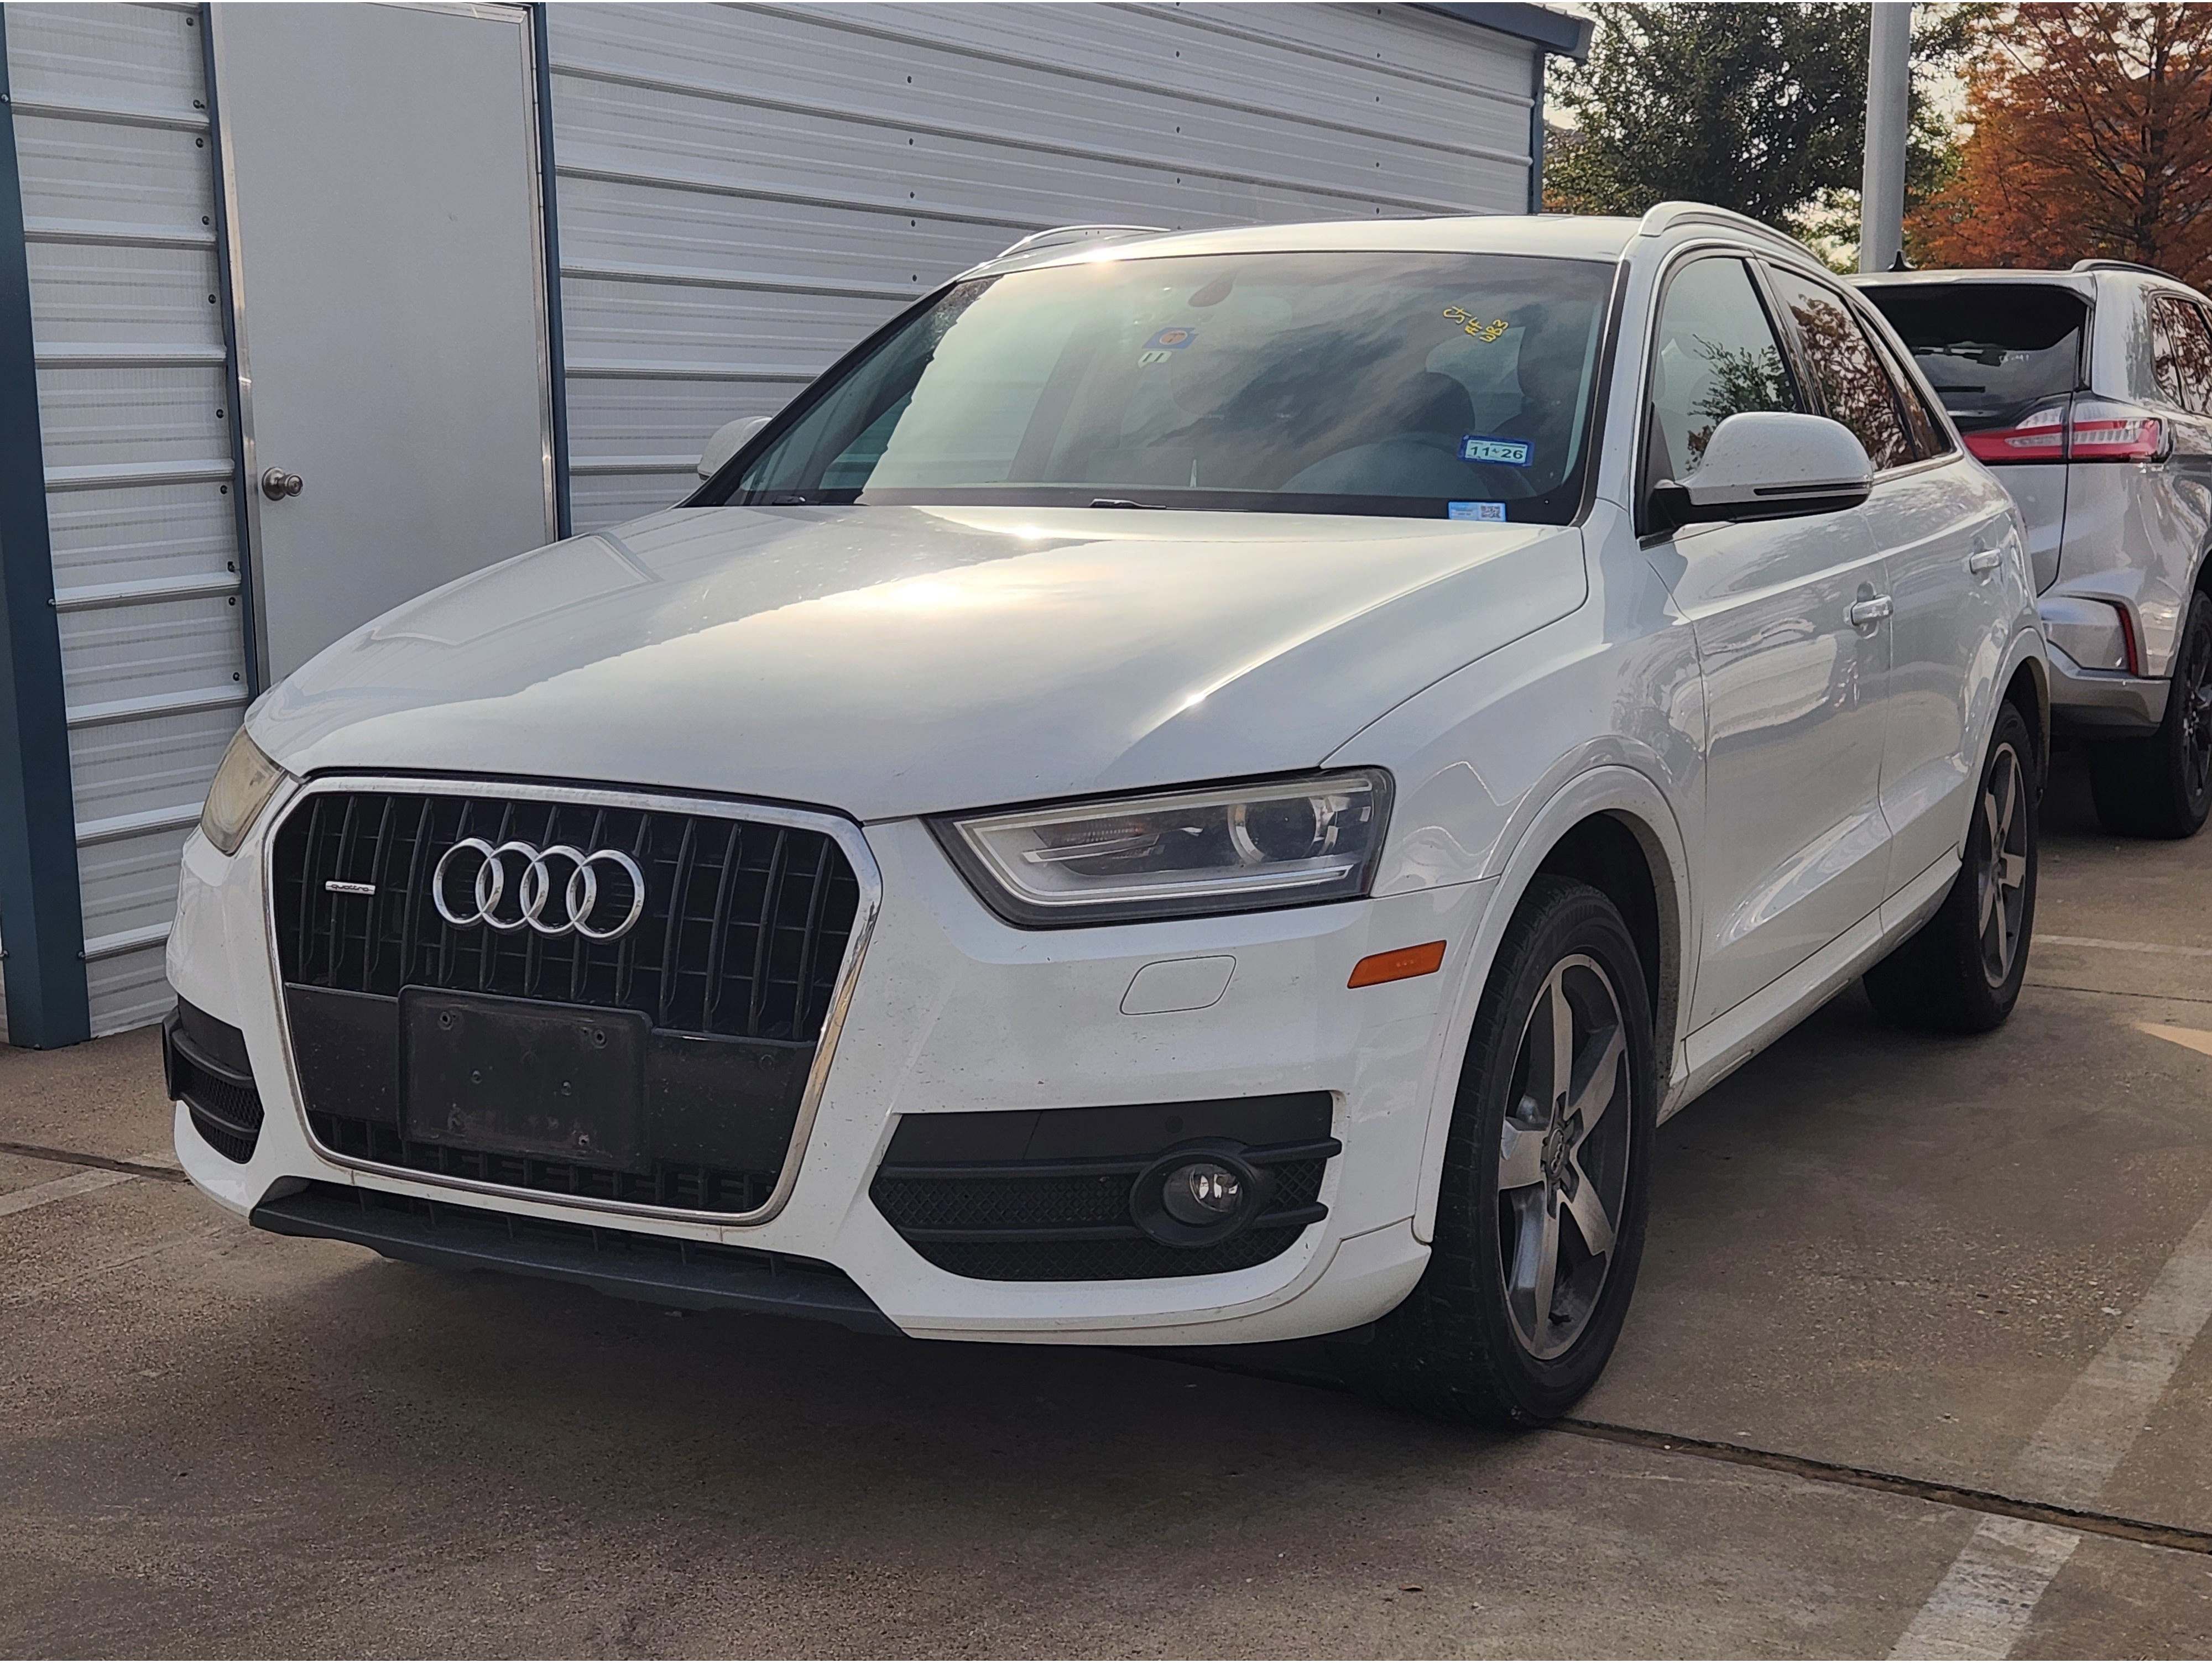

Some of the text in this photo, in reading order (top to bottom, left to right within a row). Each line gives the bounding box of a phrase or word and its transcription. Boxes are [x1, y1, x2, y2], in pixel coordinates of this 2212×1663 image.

[1470, 446, 1524, 459] 11 26
[330, 883, 371, 892] quattro
